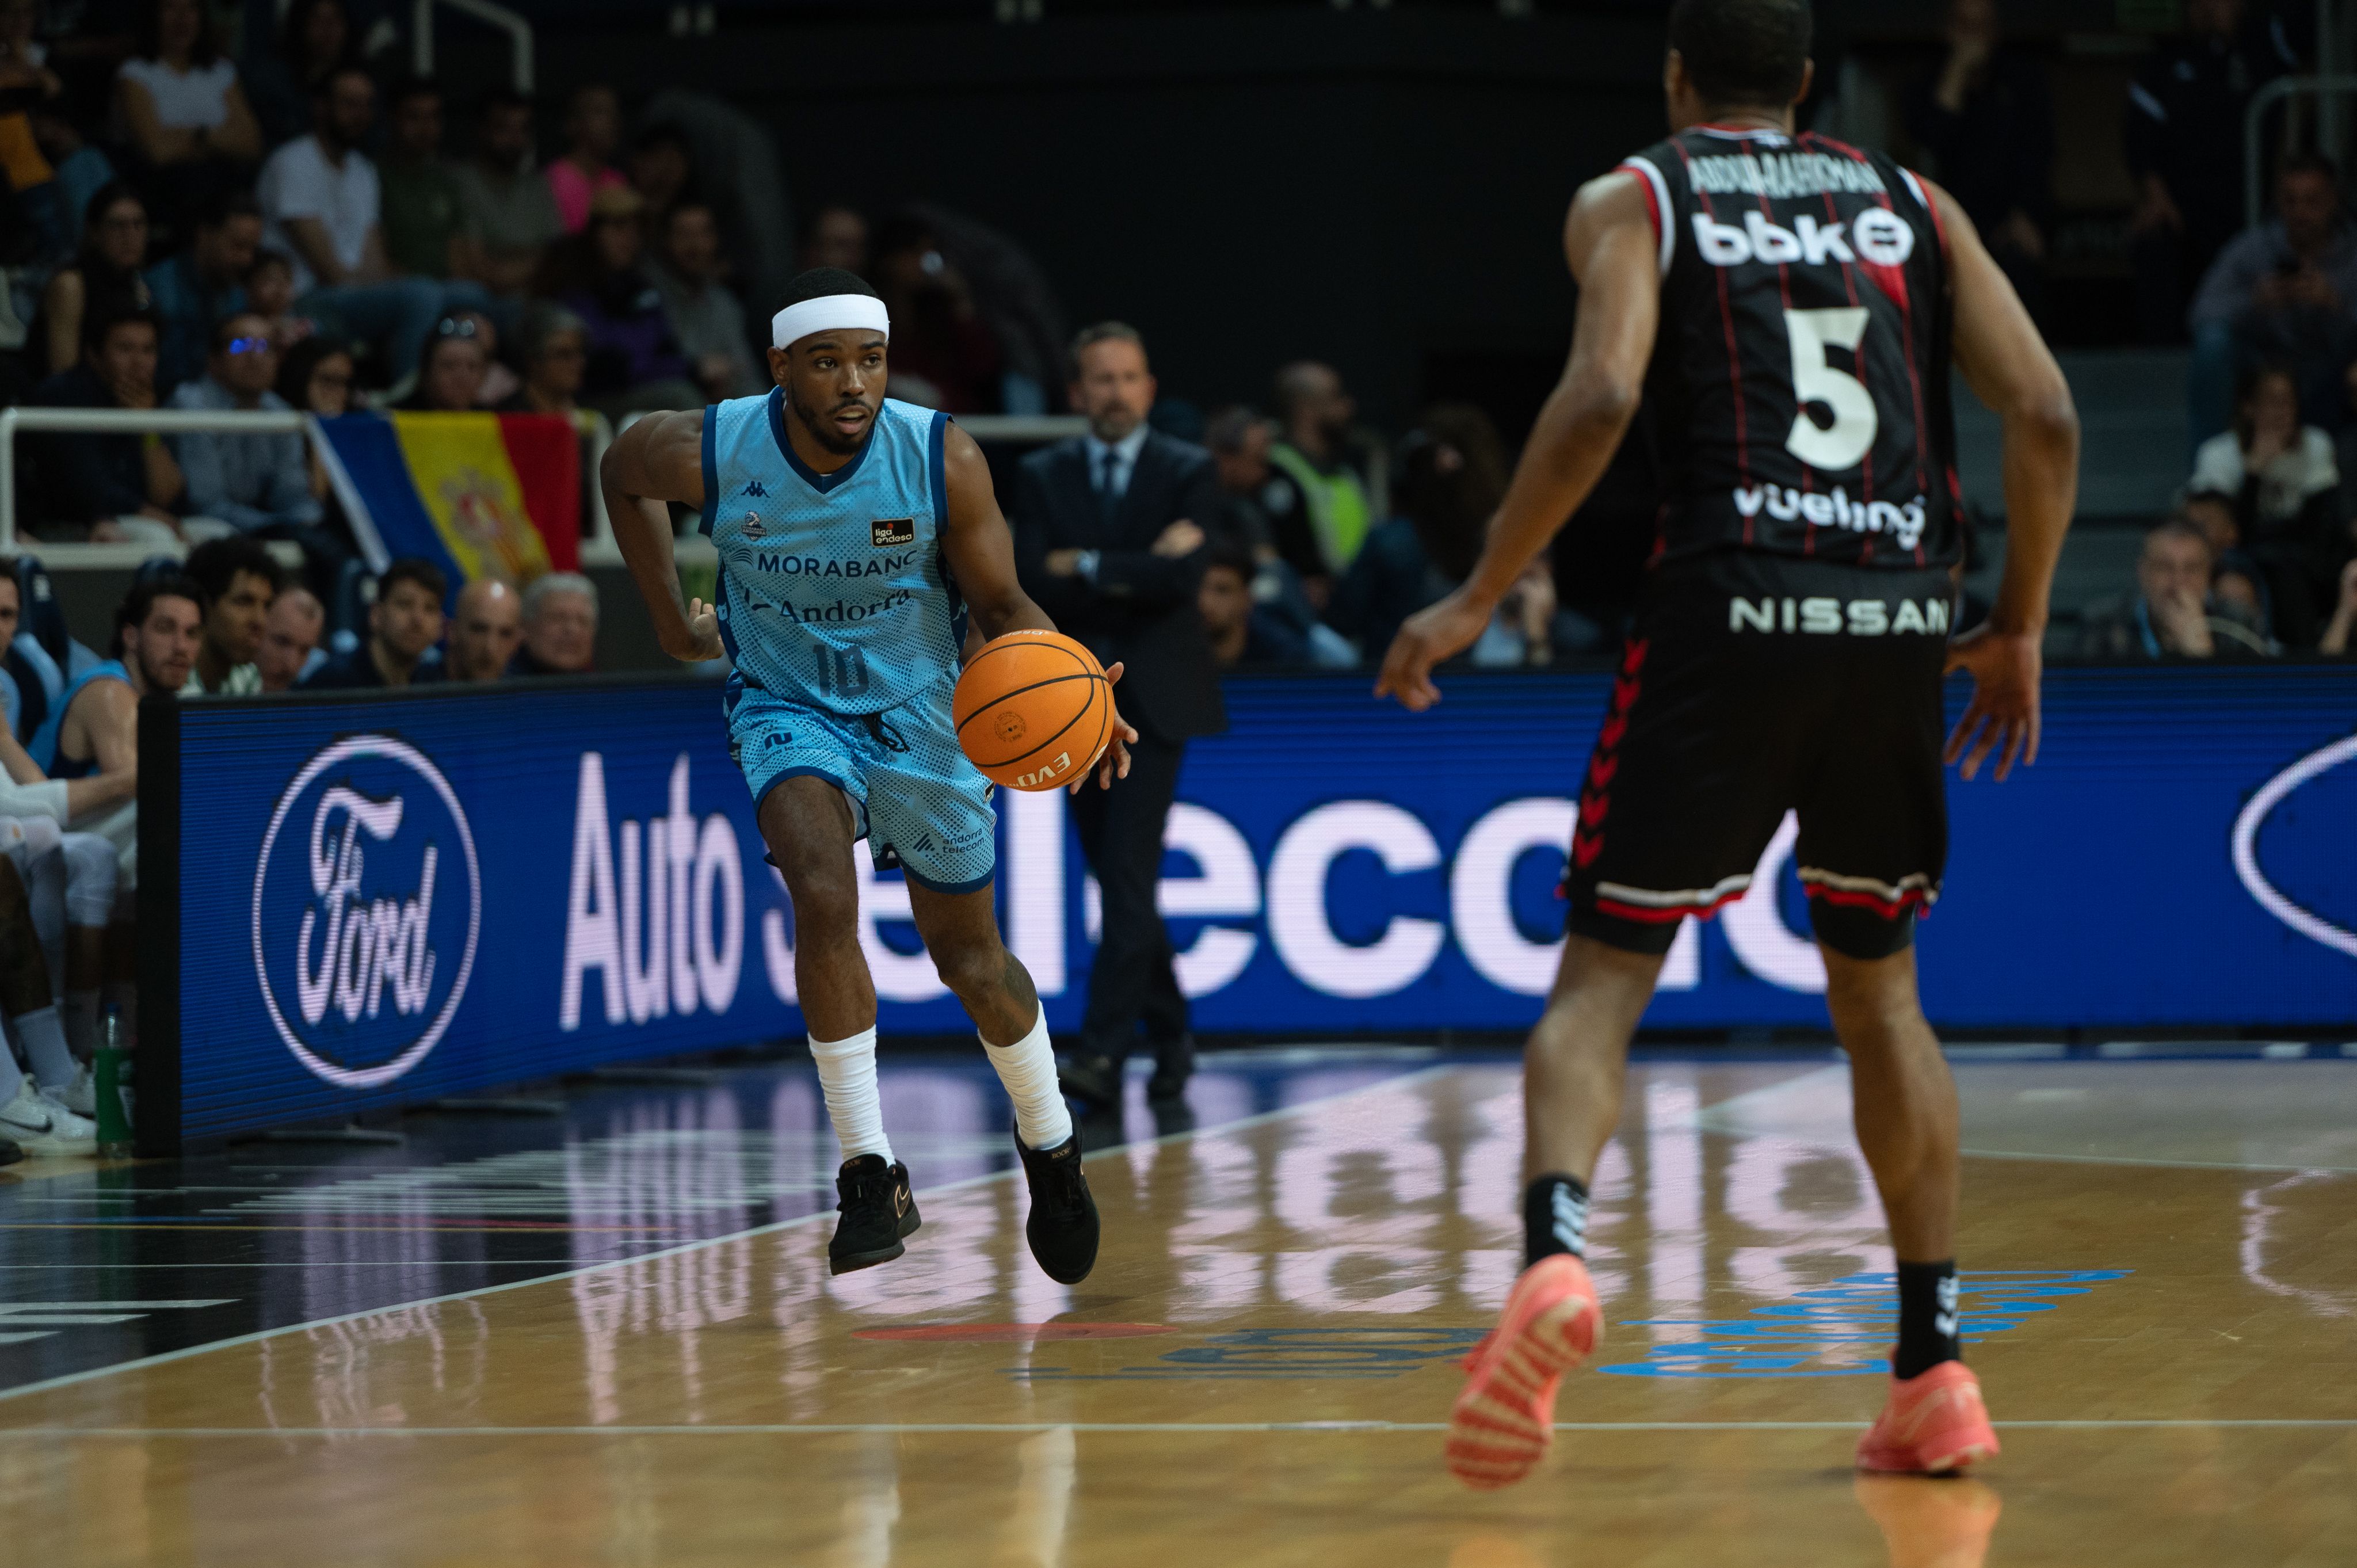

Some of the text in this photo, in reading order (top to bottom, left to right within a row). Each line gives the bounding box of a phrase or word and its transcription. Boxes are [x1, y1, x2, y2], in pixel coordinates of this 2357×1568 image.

[1691, 210, 1856, 266] bbk
[1784, 306, 1878, 471] 5
[875, 528, 892, 537] liga
[1733, 482, 1927, 551] vueling
[876, 534, 912, 544] endesa
[758, 550, 917, 577] MORABANC
[779, 589, 910, 624] Andorra
[1729, 596, 1951, 636] NISSAN
[812, 643, 869, 698] 10
[1017, 751, 1071, 787] EVO
[942, 837, 985, 854] telecom
[943, 828, 983, 845] andorra
[296, 785, 438, 1026] Ford
[558, 750, 745, 1033] Auto
